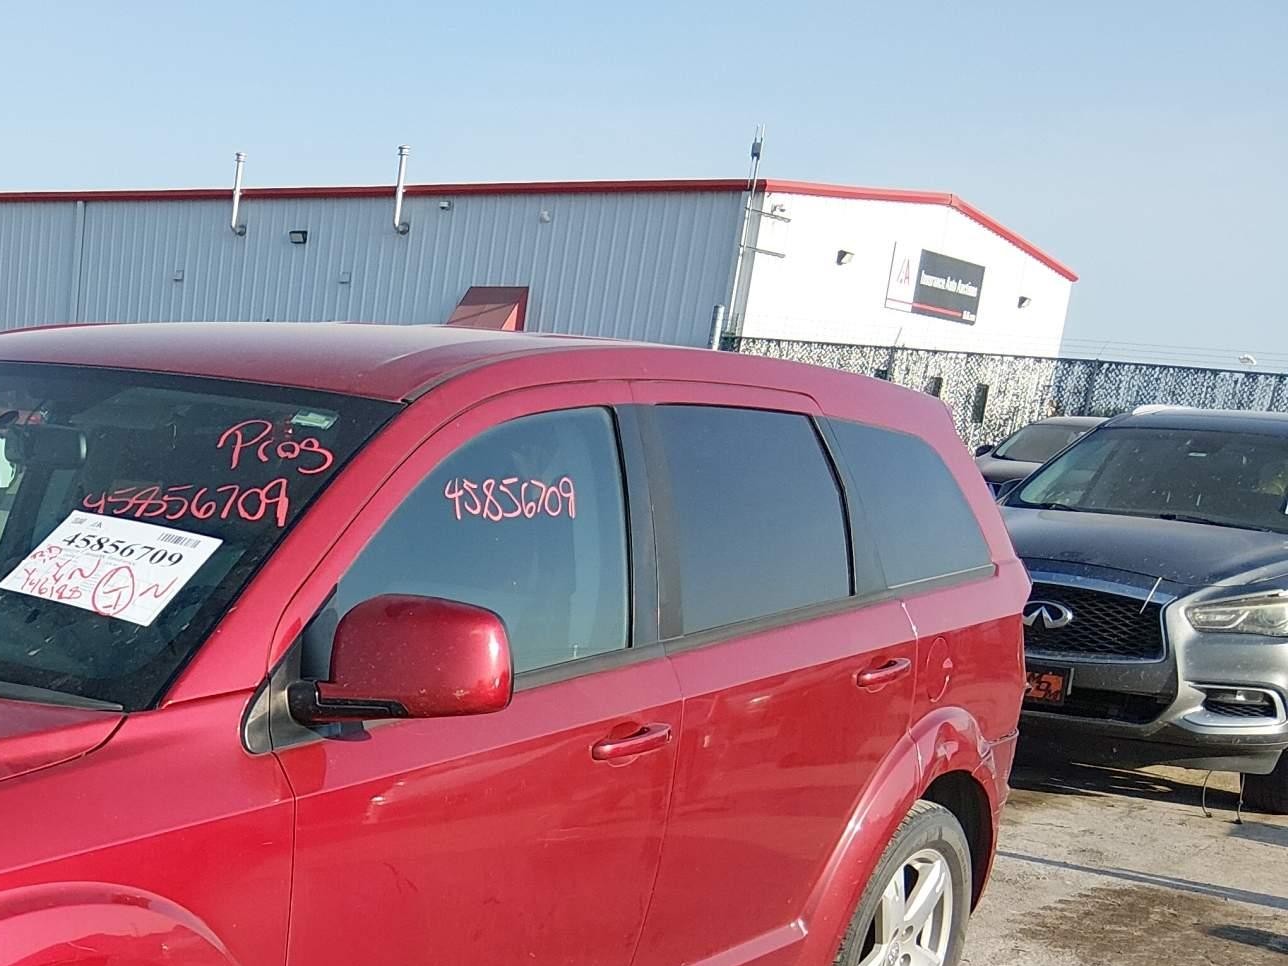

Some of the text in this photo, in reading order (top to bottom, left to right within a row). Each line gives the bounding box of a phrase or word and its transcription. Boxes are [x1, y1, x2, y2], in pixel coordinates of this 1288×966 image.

[82, 478, 289, 528] 45856709
[444, 476, 577, 522] 45856709
[63, 531, 185, 568] 45856709
